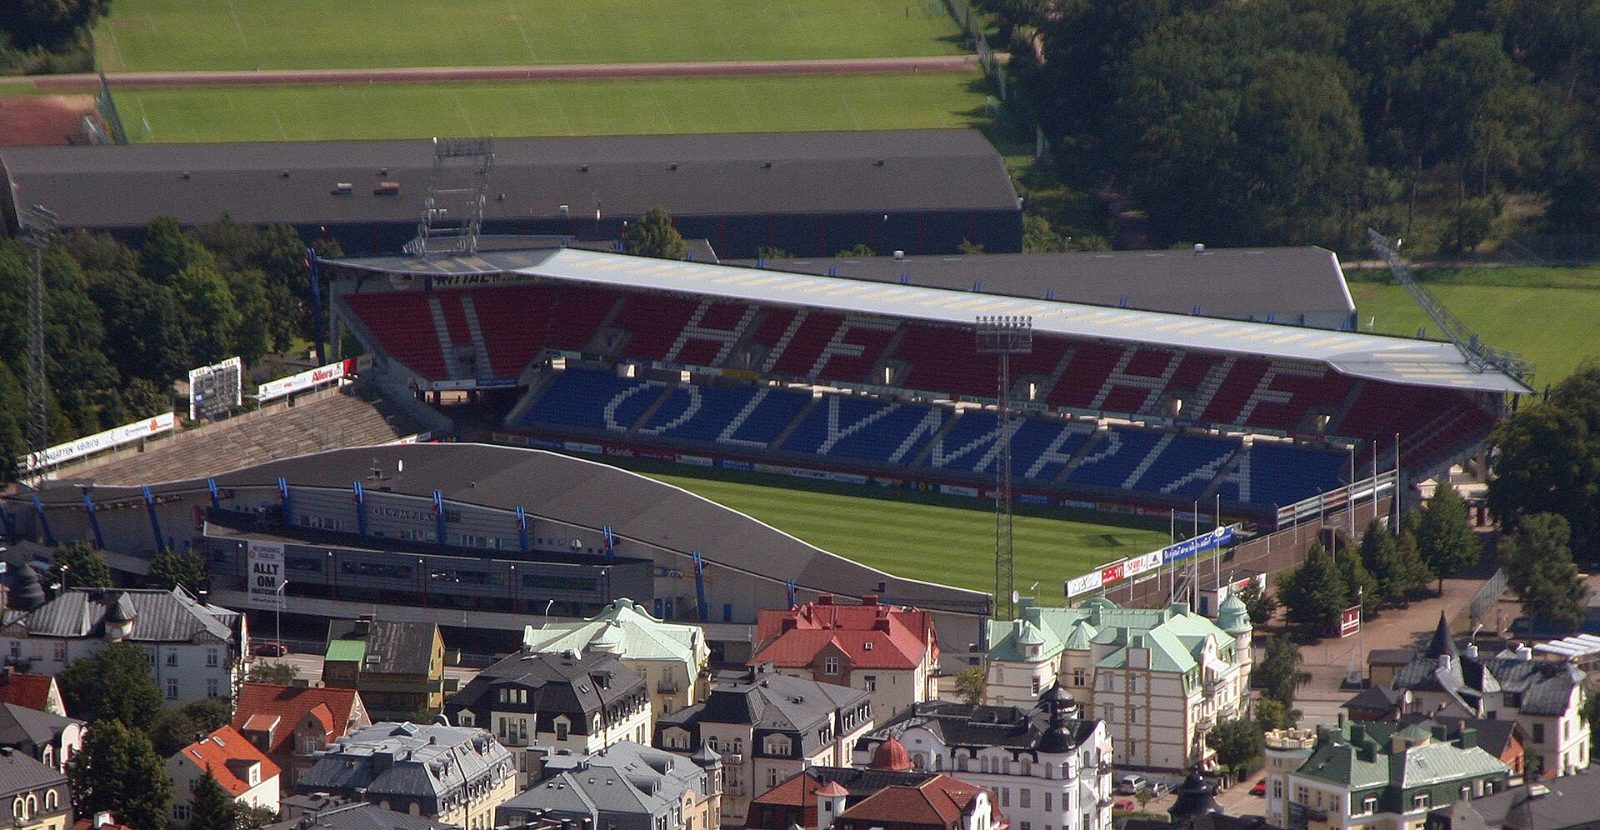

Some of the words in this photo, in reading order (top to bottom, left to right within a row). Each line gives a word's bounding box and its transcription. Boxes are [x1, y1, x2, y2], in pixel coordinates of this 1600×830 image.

[664, 299, 900, 379] HIF
[1089, 345, 1329, 426] HIF
[312, 369, 333, 384] Allers
[603, 380, 1251, 501] OLYMPIA
[253, 562, 279, 575] ALLT
[257, 575, 275, 588] OM
